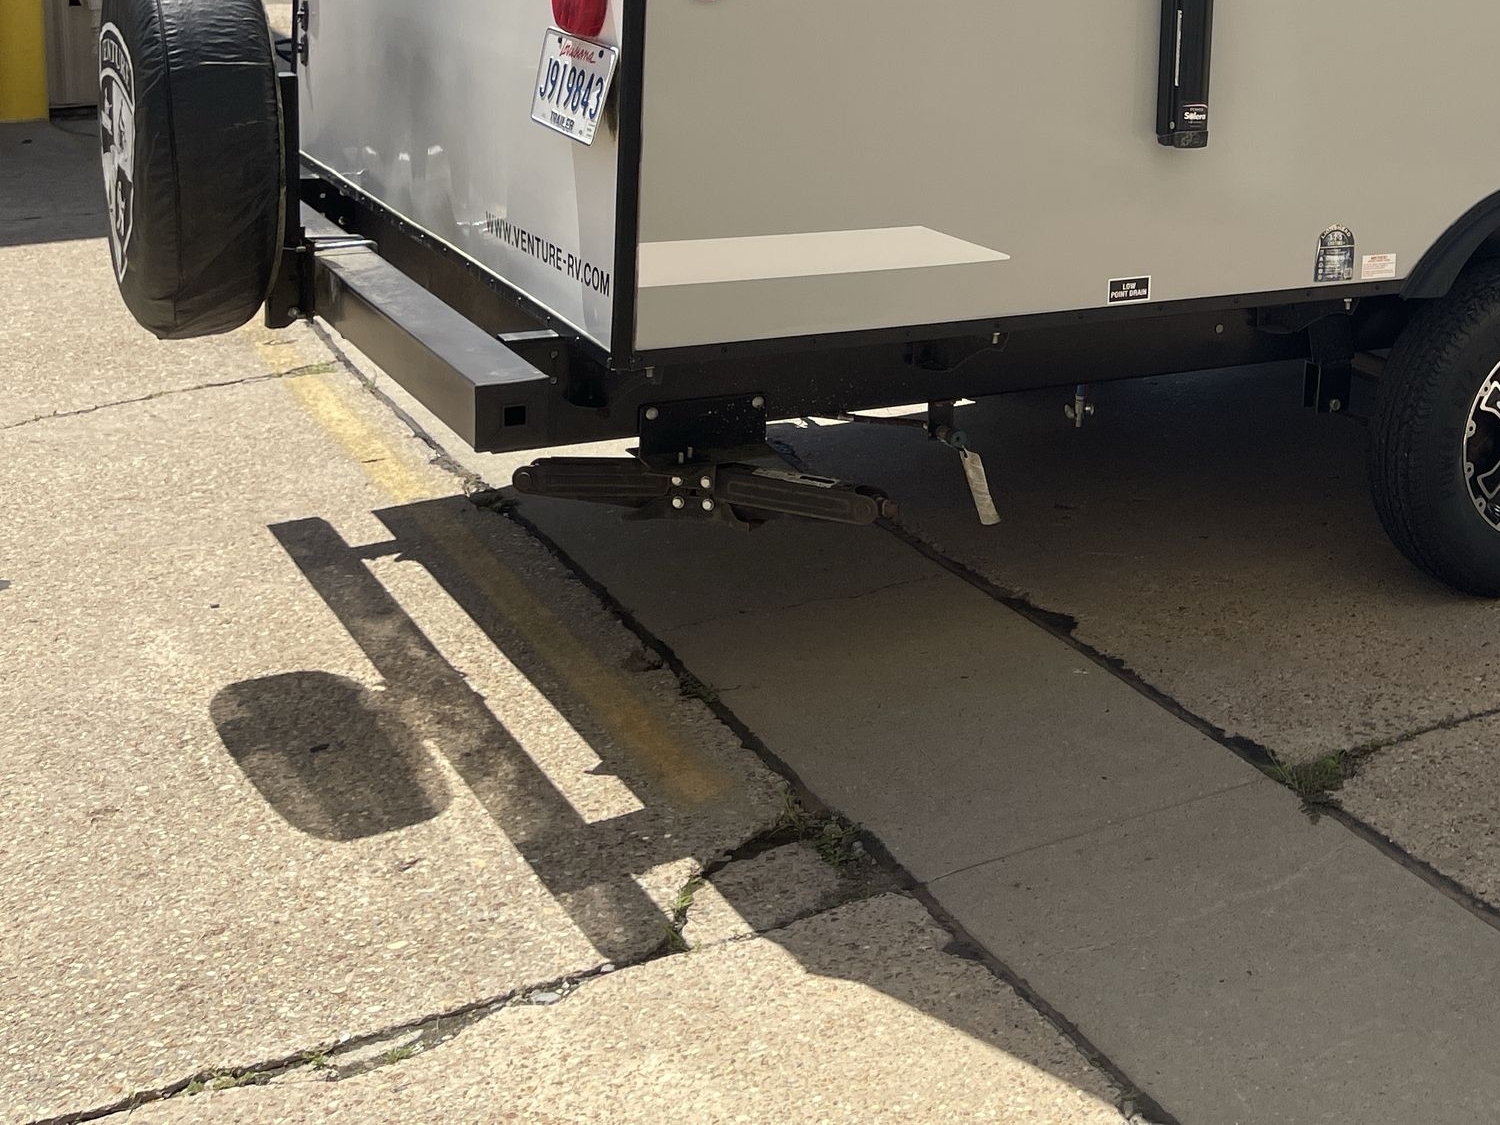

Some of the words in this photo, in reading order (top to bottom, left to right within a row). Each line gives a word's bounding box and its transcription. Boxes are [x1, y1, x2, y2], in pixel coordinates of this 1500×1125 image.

[539, 57, 604, 121] J919843
[550, 110, 576, 131] TRAILER
[485, 210, 610, 297] WWW.VENTURE-RV.COM
[1122, 282, 1137, 290] LOW
[1129, 288, 1147, 297] DRAIN
